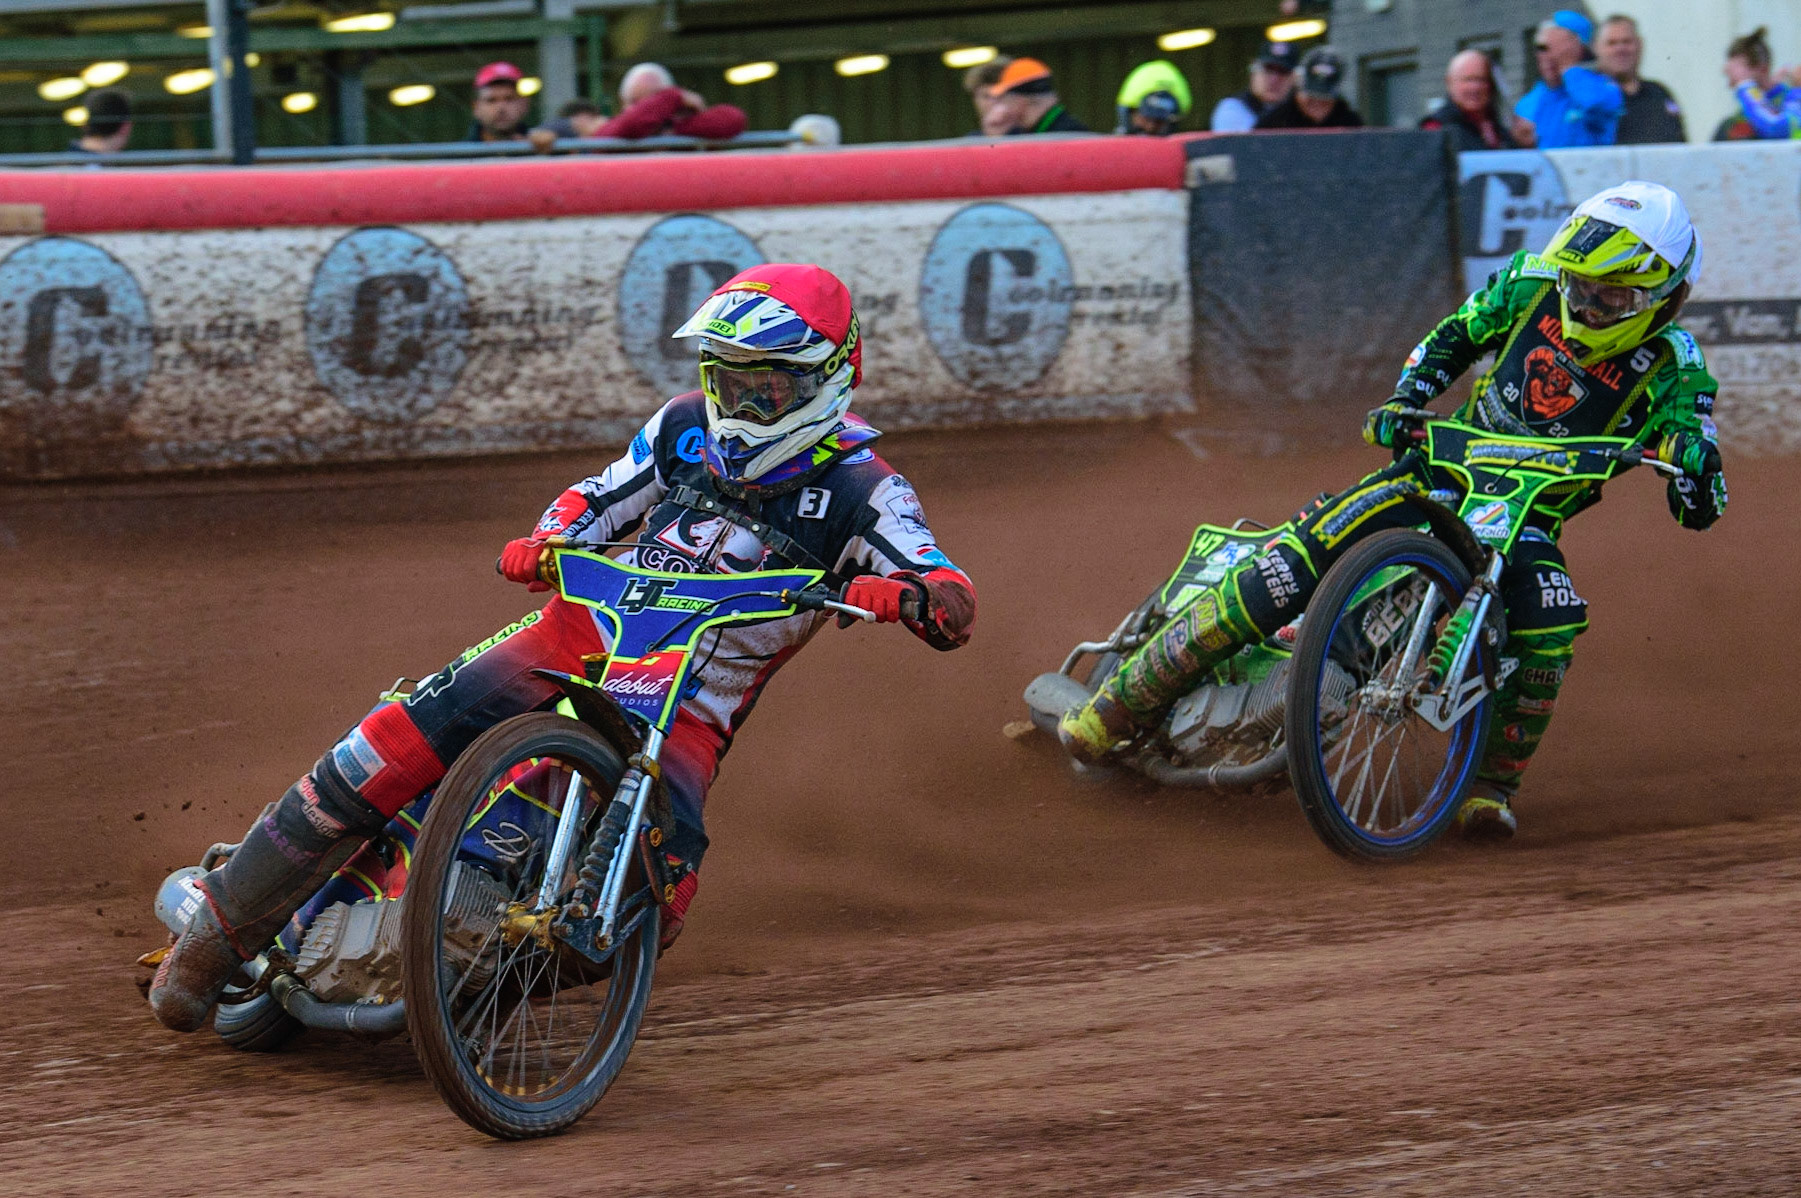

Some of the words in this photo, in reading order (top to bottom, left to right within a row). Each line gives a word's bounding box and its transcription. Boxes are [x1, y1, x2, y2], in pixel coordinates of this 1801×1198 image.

[1629, 346, 1656, 373] 5
[1502, 381, 1520, 402] 20
[1548, 422, 1570, 438] 22
[803, 489, 824, 516] 3
[1194, 532, 1226, 557] 47
[1267, 549, 1300, 595] TERRY
